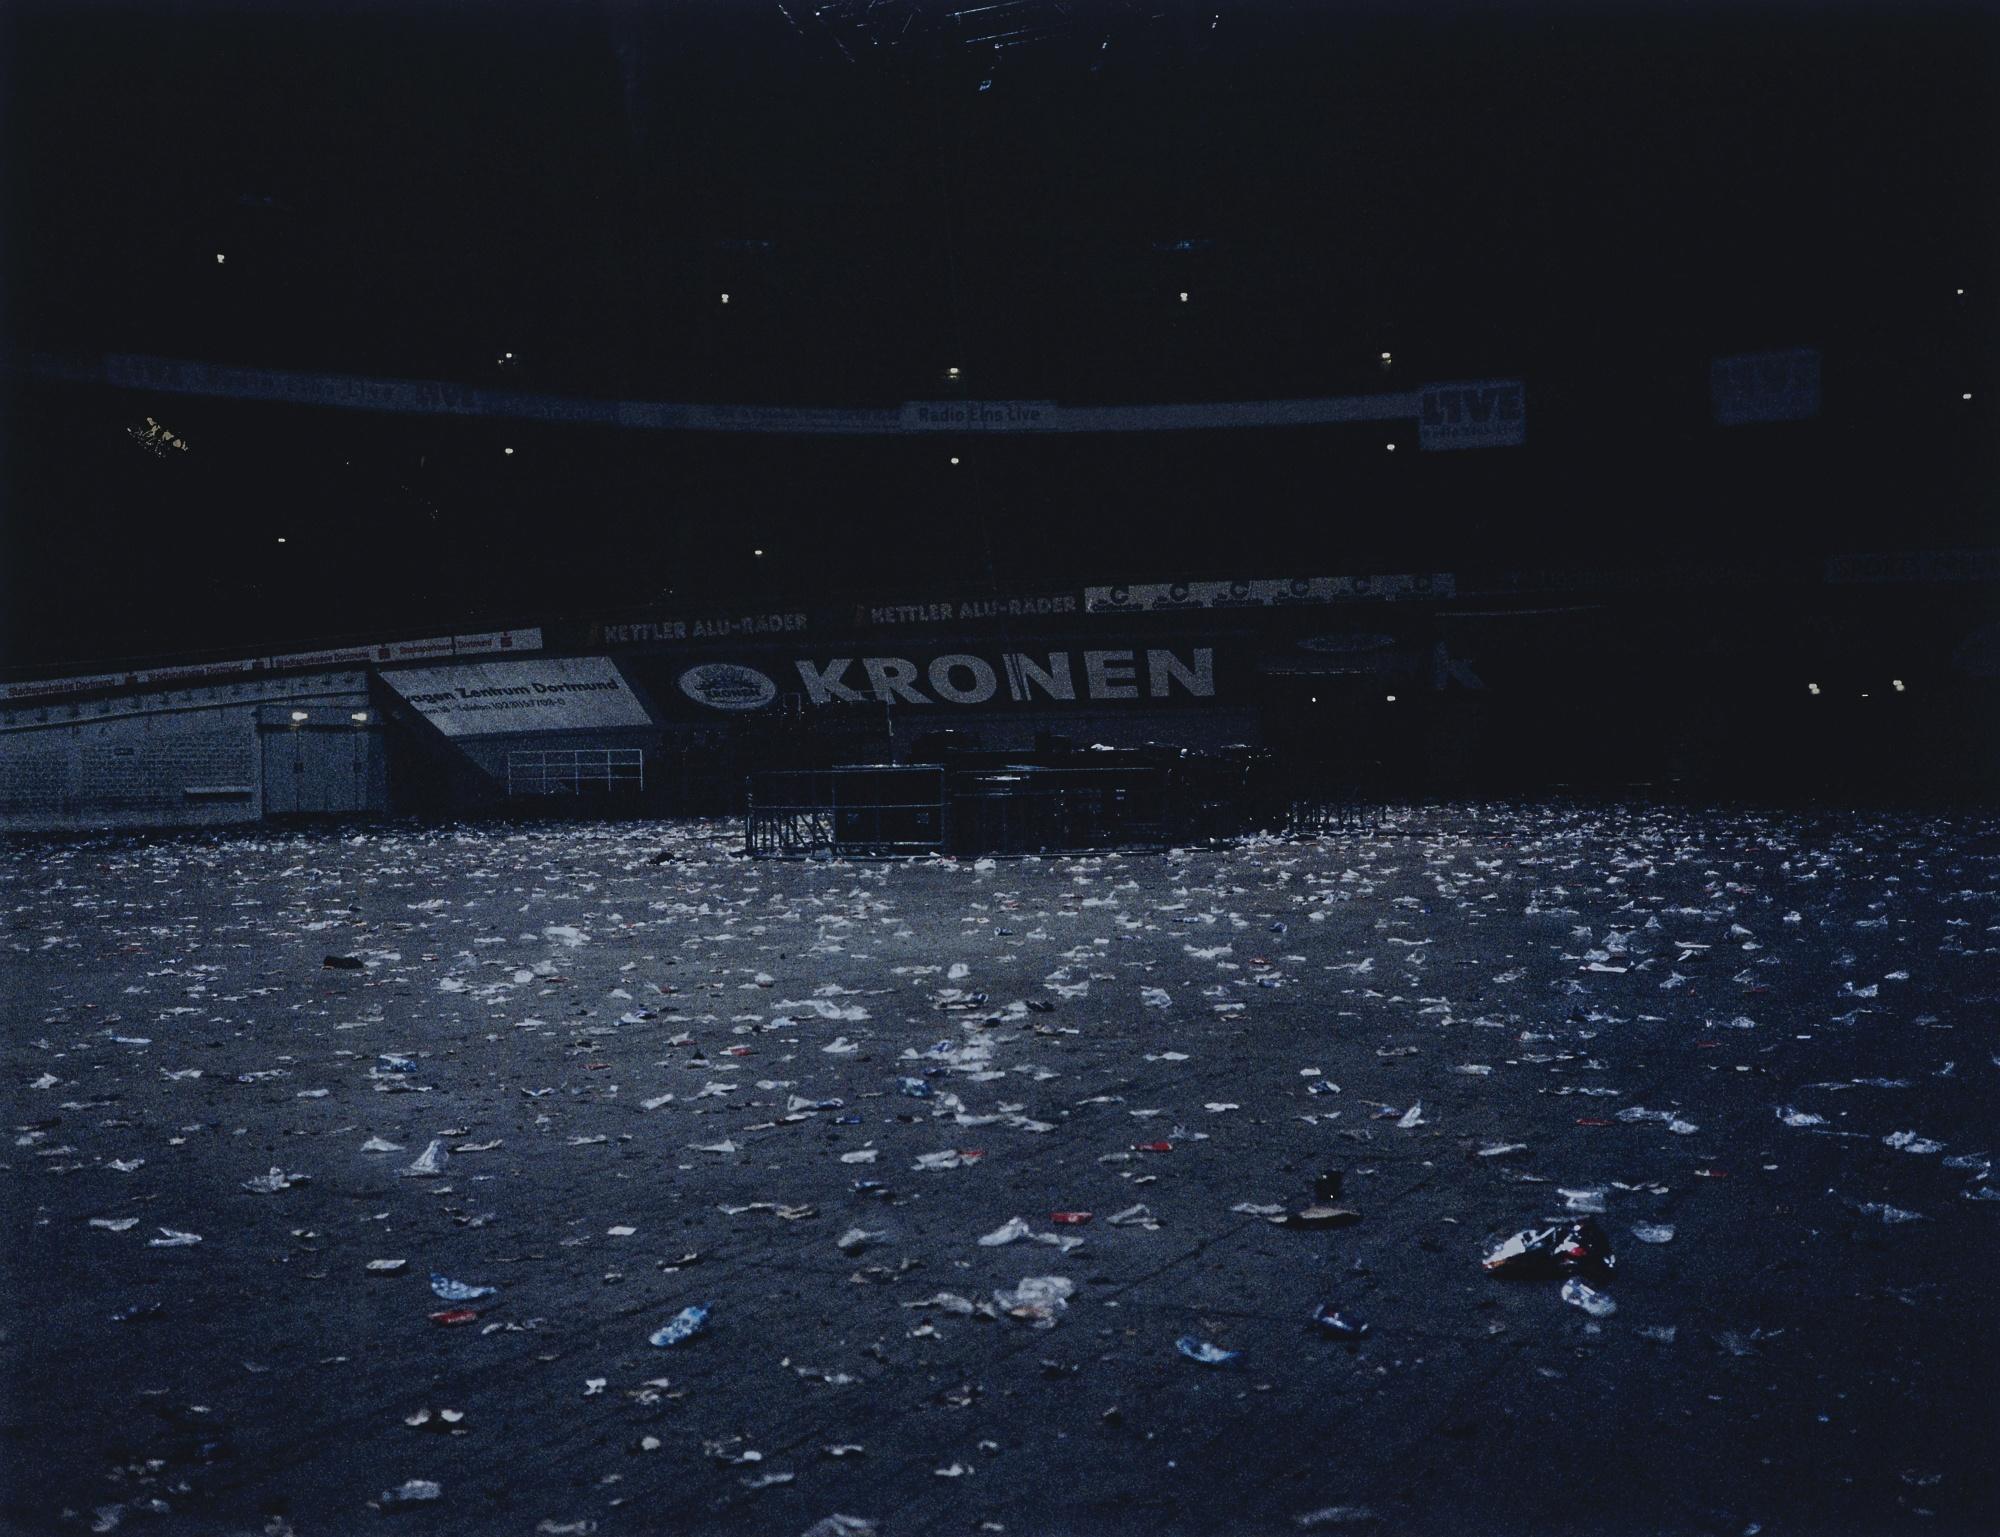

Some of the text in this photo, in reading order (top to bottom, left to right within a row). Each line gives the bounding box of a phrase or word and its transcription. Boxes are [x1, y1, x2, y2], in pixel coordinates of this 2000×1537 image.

[919, 406, 1040, 422] Radio Eins Live
[871, 603, 953, 624] KETTLER
[959, 596, 1076, 619] ALU-RÄDER
[604, 621, 687, 643] KETTLER
[76, 678, 115, 691] Dortmund
[795, 648, 1215, 705] KRONEN
[455, 685, 531, 699] Zentrum
[532, 678, 619, 694] Dortmund
